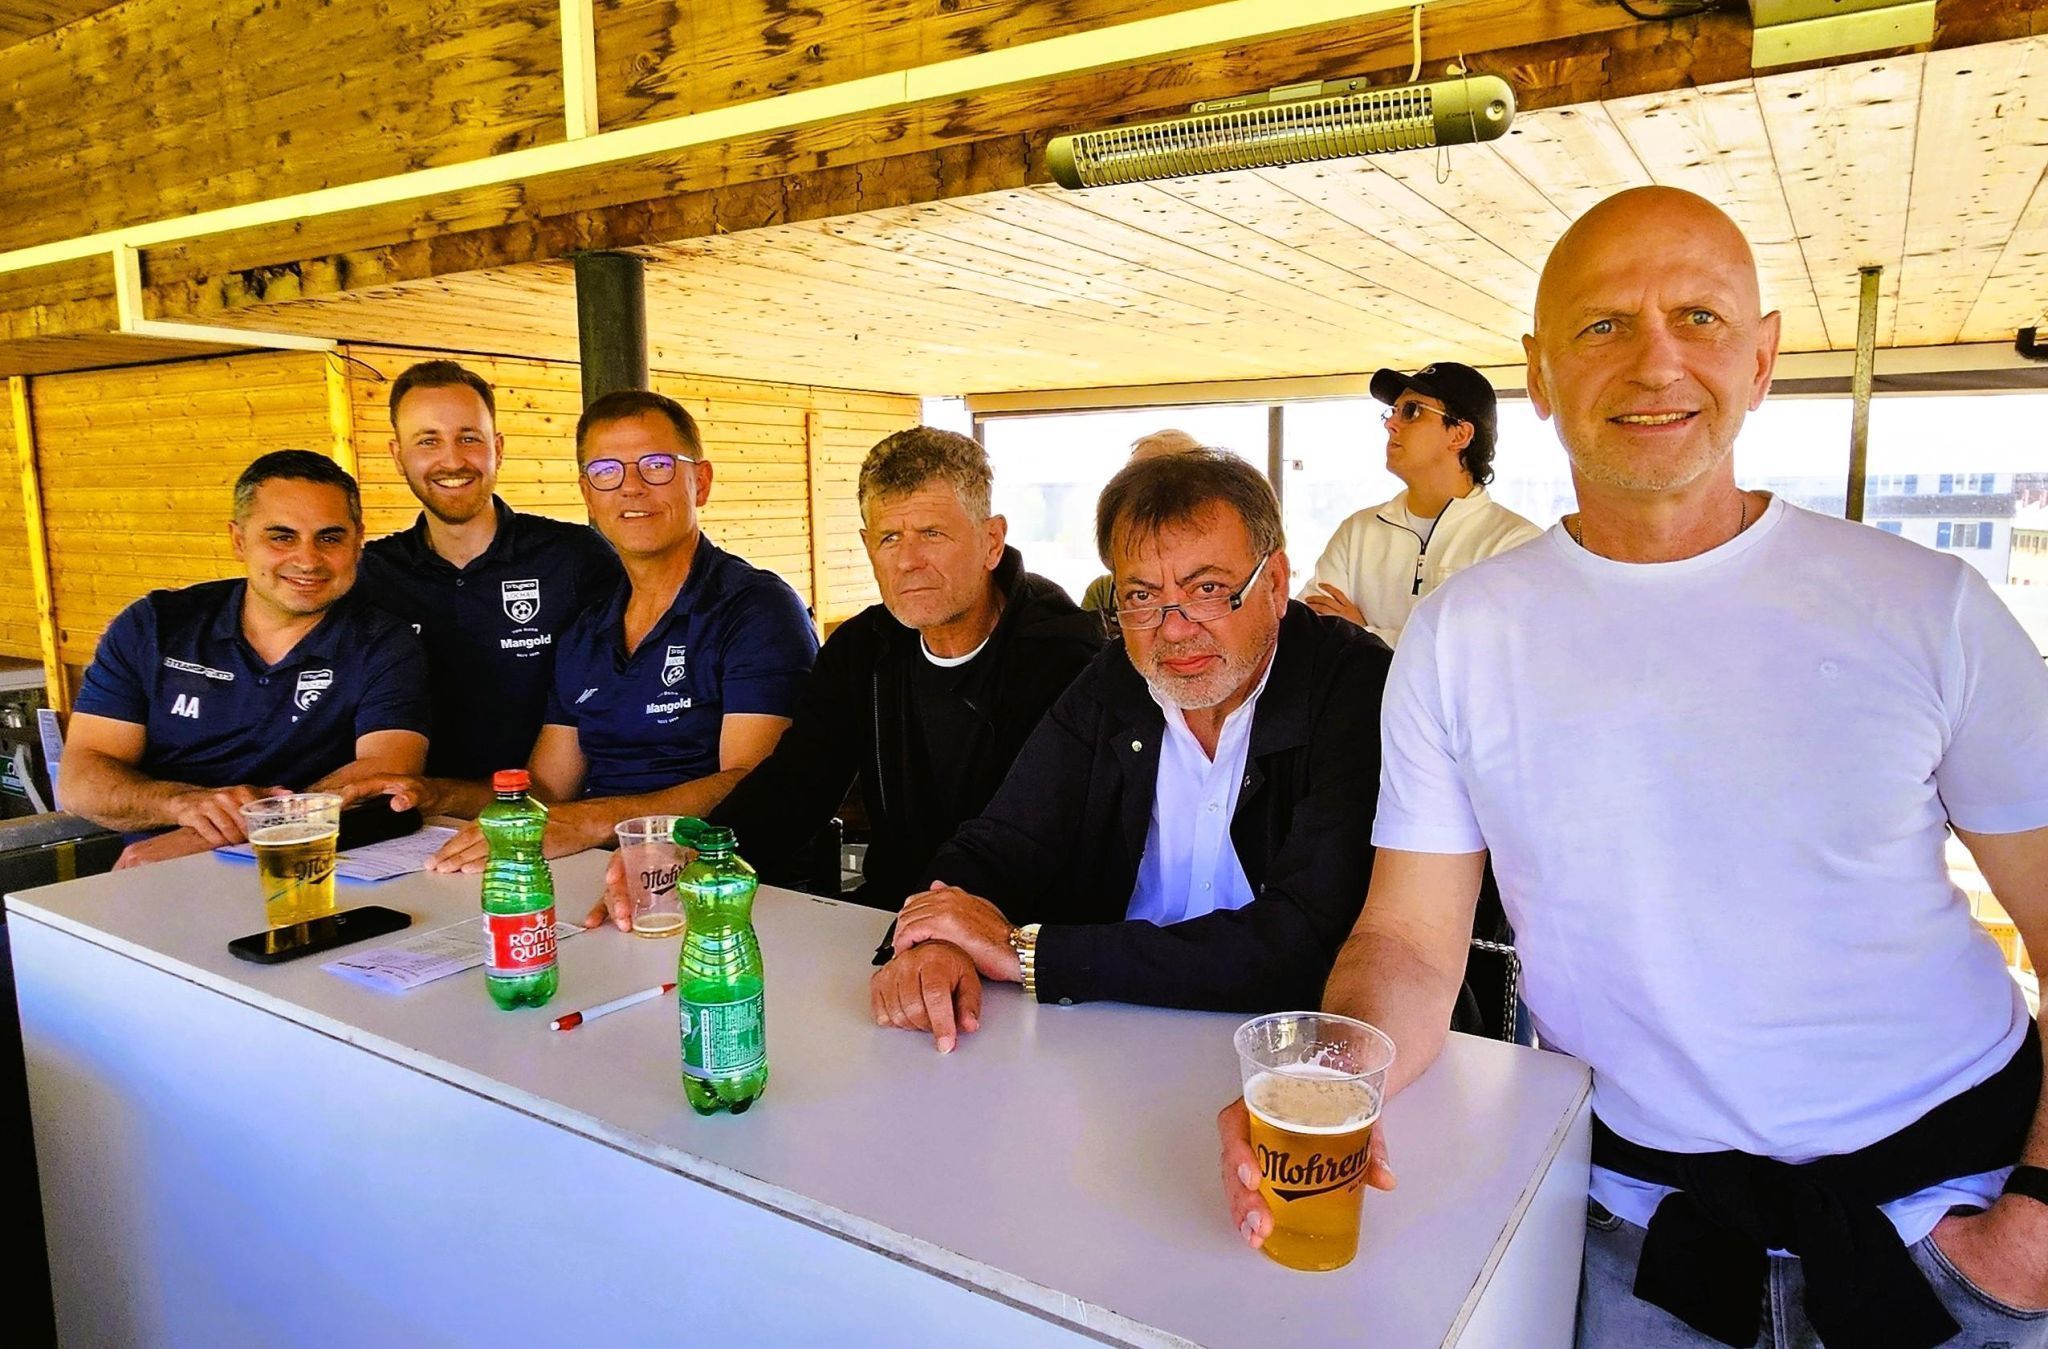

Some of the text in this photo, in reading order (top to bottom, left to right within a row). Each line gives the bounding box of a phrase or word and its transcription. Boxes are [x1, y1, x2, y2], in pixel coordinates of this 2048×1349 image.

[500, 633, 552, 648] Mangold
[171, 694, 200, 719] AA
[645, 698, 692, 714] Mangold
